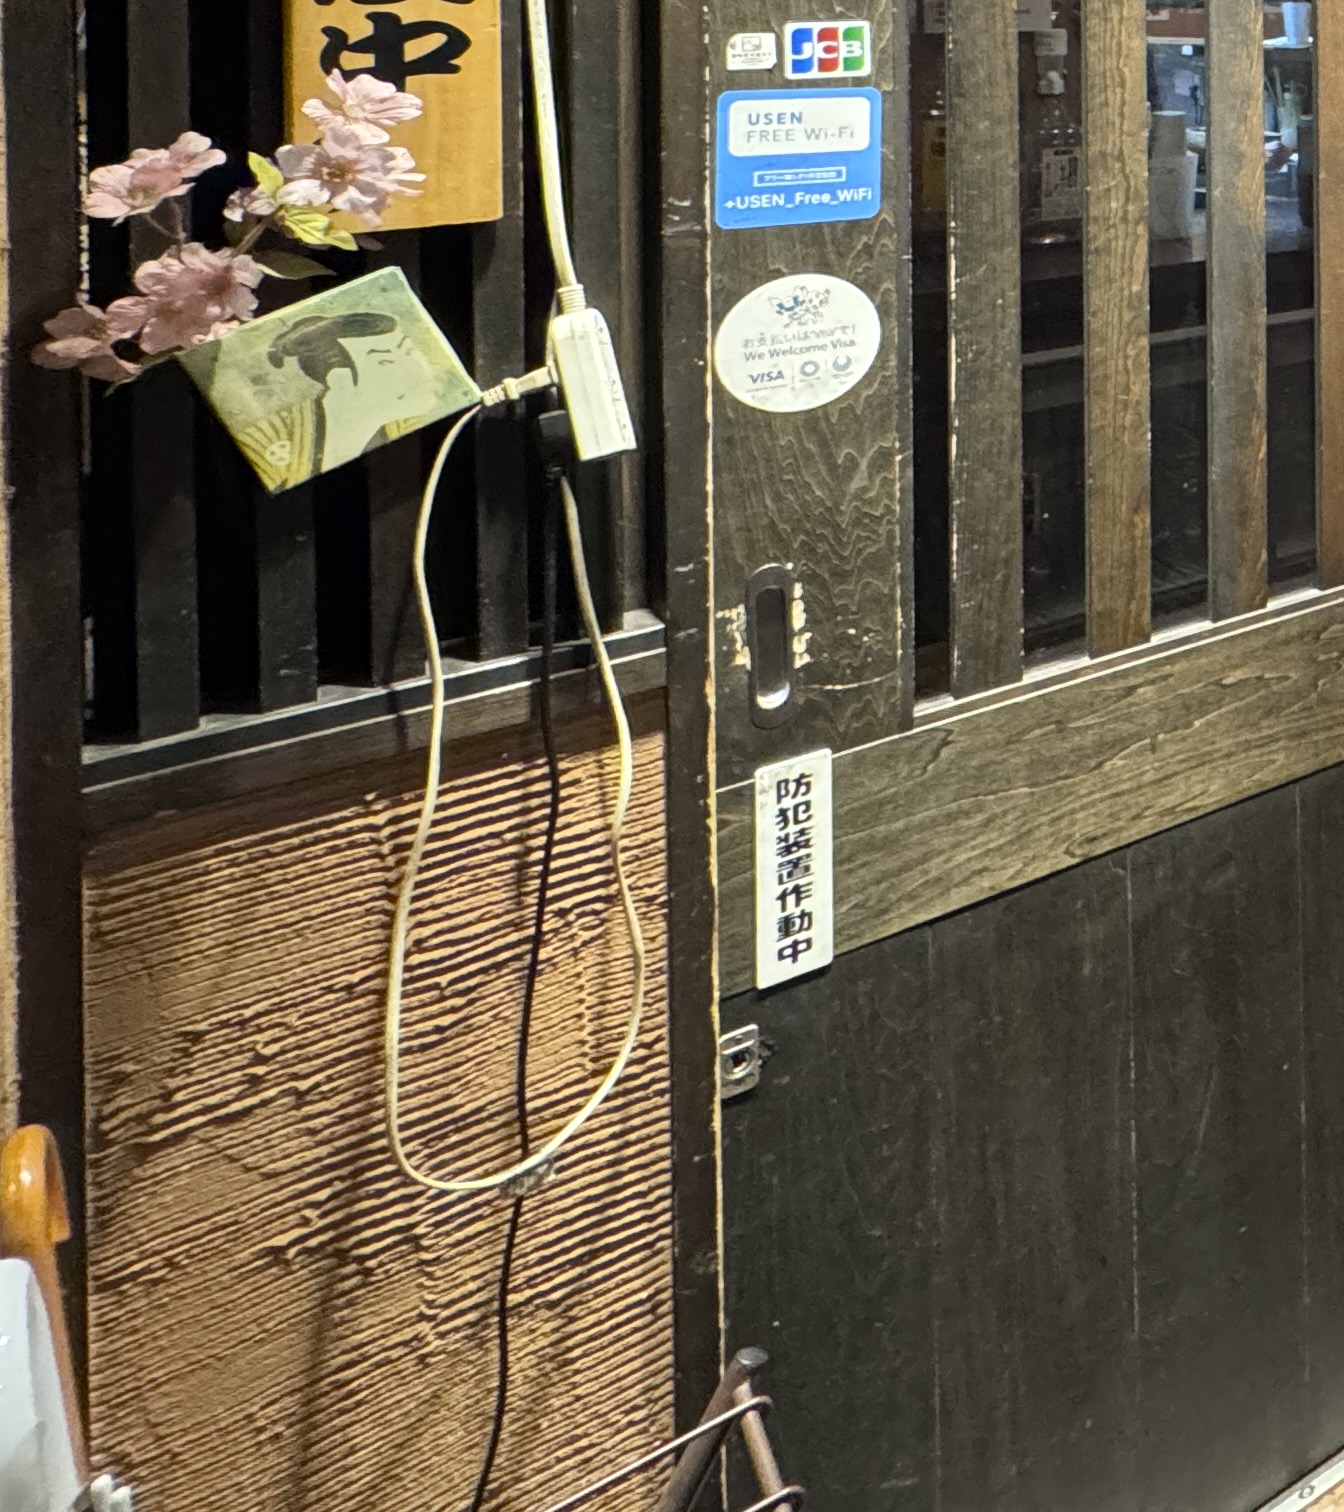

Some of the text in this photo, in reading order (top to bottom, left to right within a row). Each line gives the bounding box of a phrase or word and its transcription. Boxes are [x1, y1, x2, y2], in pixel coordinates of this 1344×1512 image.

[748, 112, 803, 126] USEN
[746, 126, 855, 143] FREE Wi-Fi
[744, 339, 856, 362] We Welcome Visa
[749, 370, 785, 384] VISA
[775, 772, 815, 965] 防犯装置作動中
